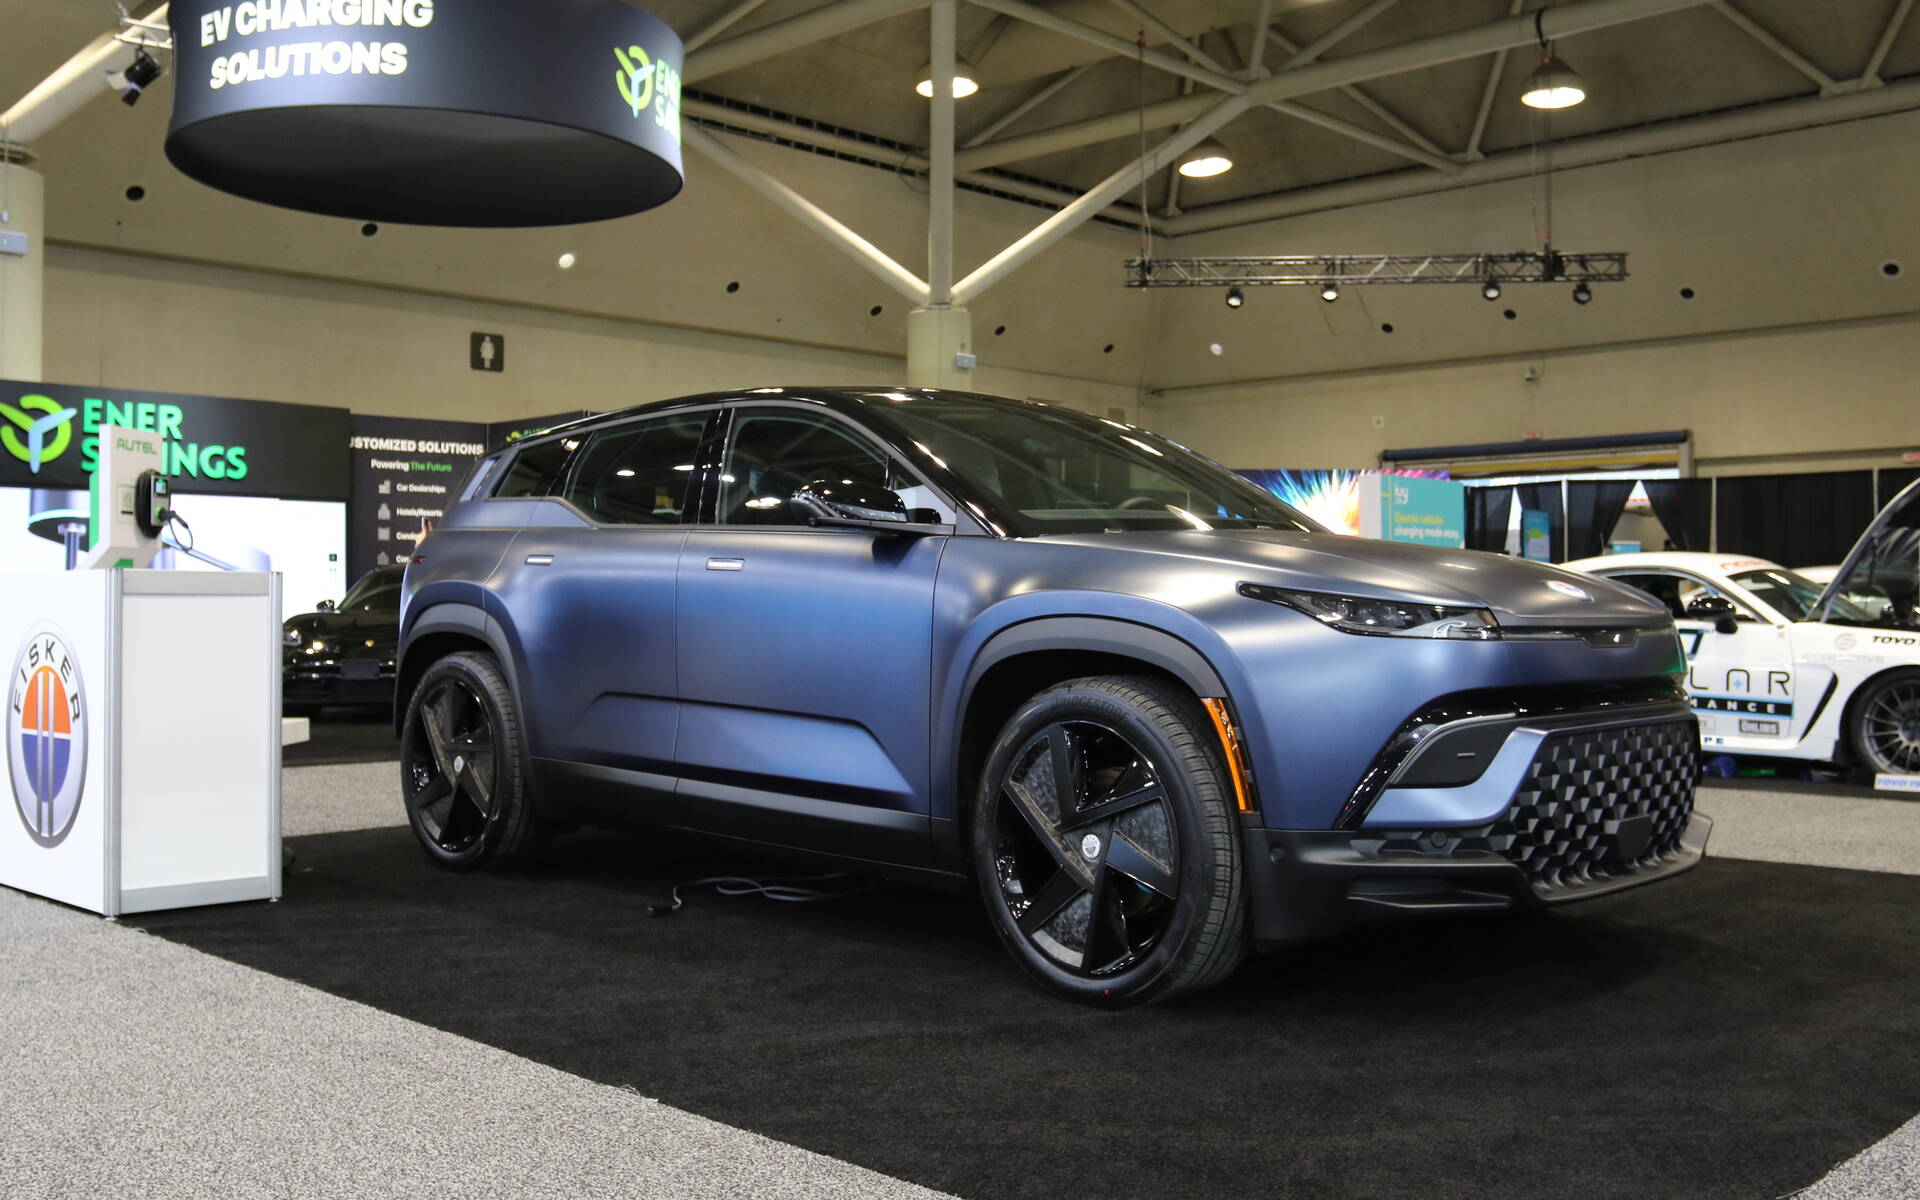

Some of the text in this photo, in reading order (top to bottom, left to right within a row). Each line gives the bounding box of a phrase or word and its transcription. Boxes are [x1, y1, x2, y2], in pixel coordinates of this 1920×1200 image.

[201, 0, 434, 47] EV CHARGING
[210, 41, 408, 89] SOLUTIONS
[83, 399, 183, 439] ENER
[81, 437, 248, 480] SINGS
[116, 438, 157, 455] AUTEL
[418, 441, 484, 455] SOLUTIONS
[371, 459, 452, 473] Powering The Future
[396, 483, 446, 494] Car Dealerships
[396, 508, 443, 518] Hotels/Resorts
[14, 639, 81, 723] FISKER
[1690, 666, 1790, 696] LAR
